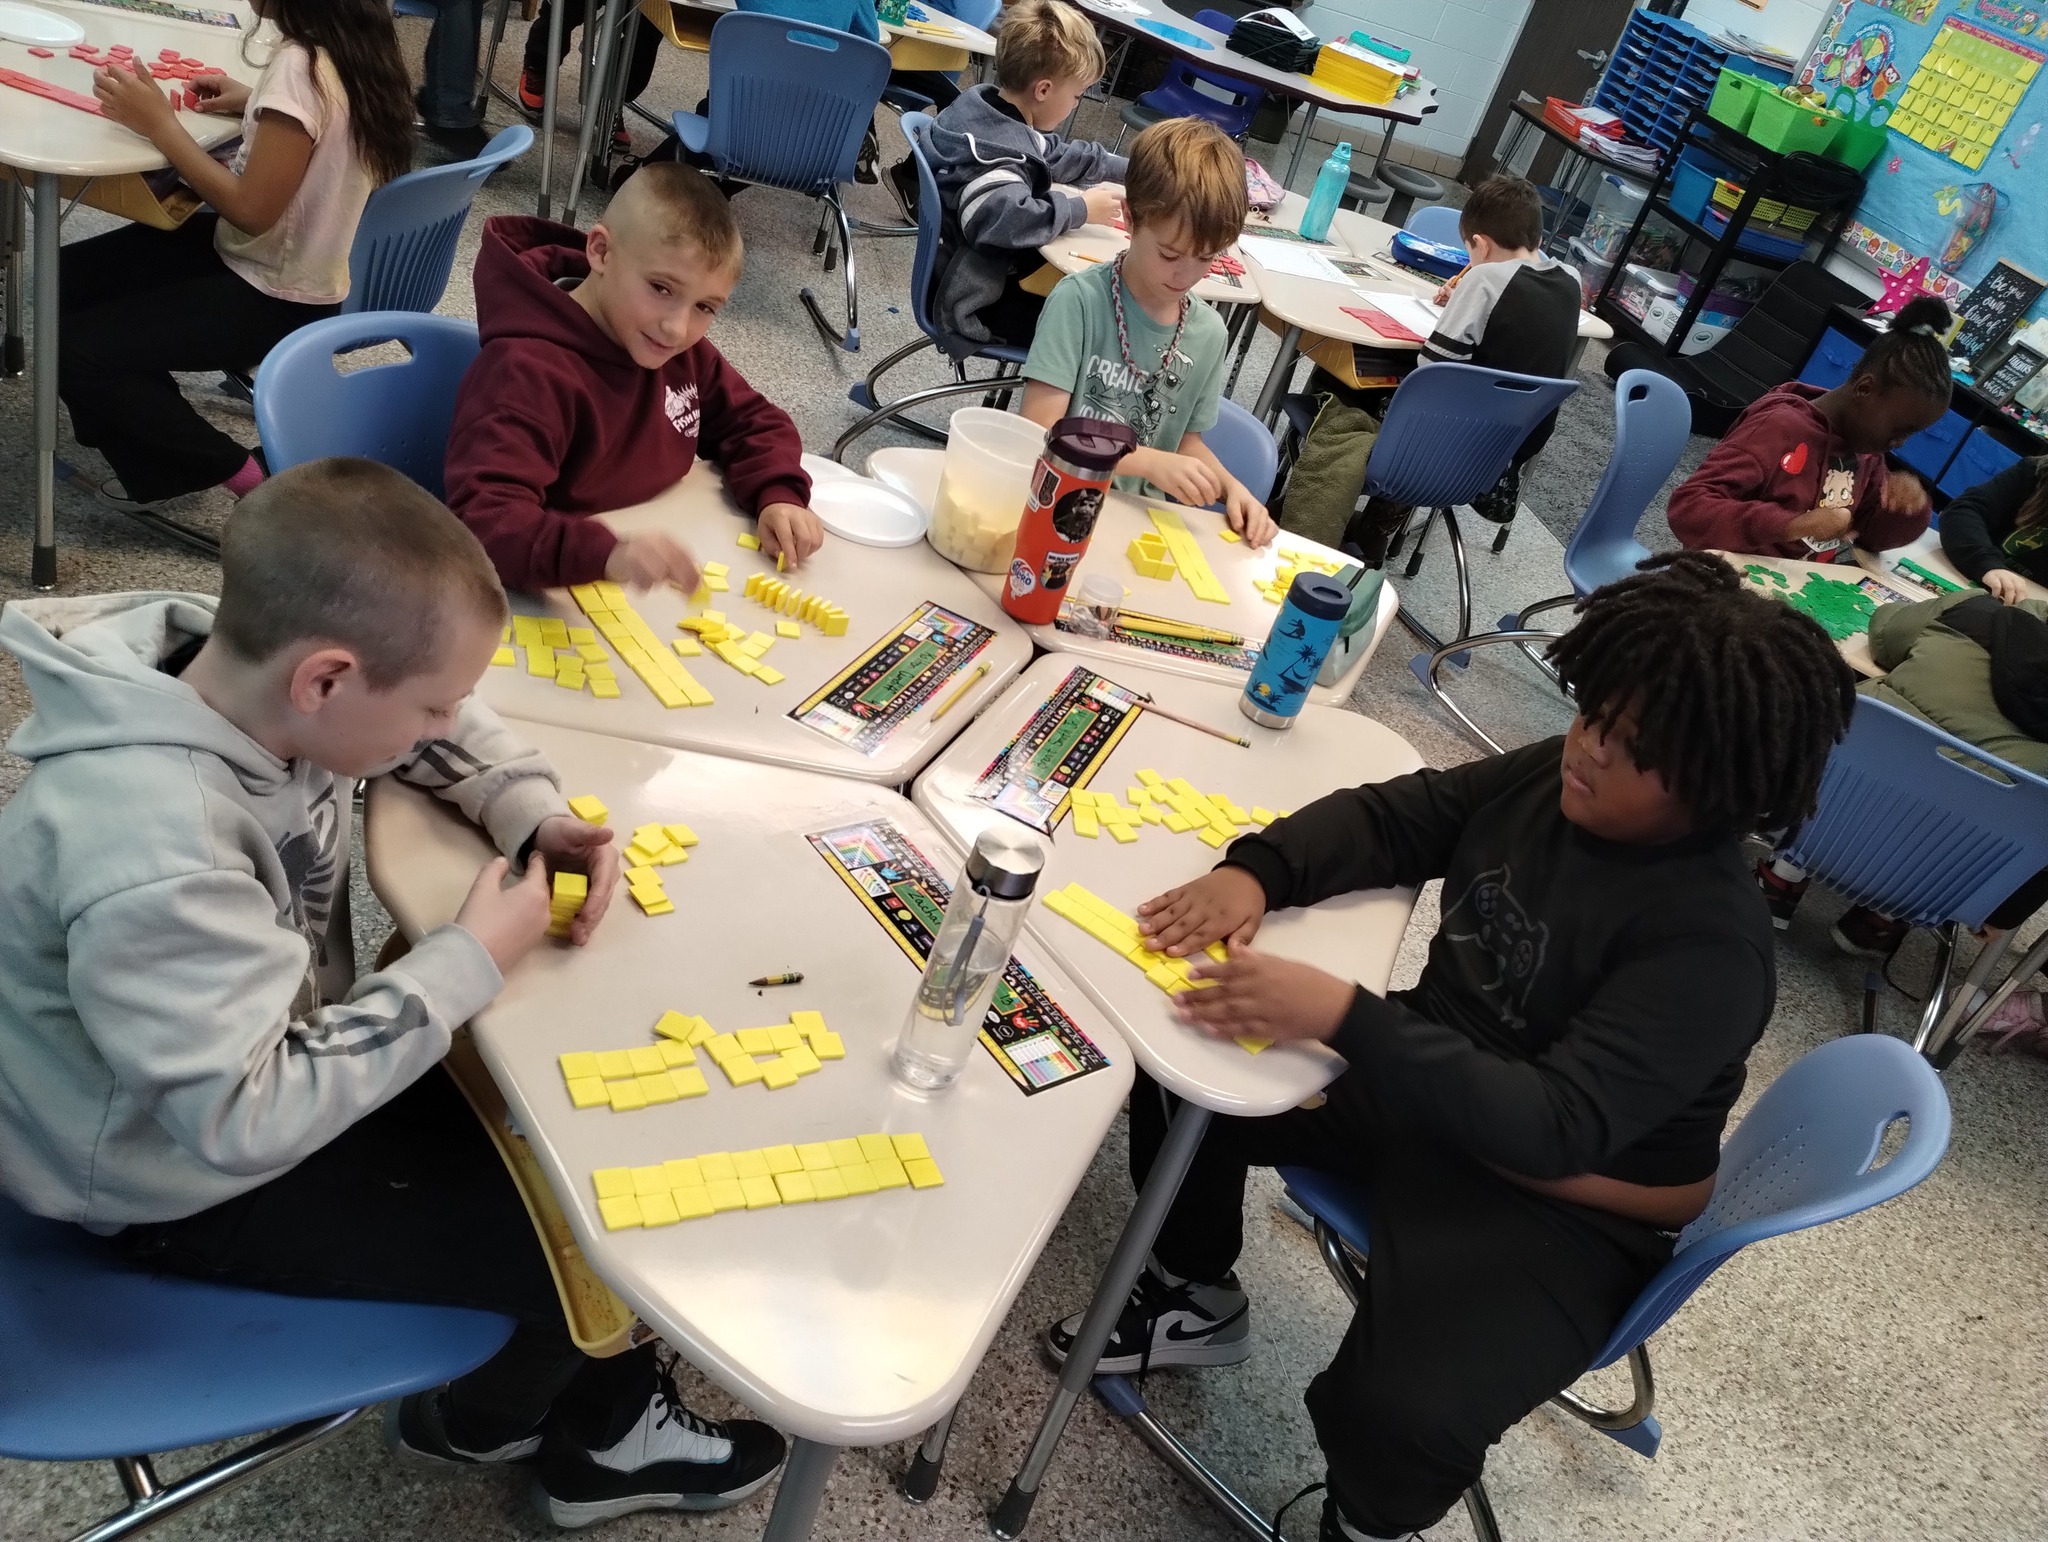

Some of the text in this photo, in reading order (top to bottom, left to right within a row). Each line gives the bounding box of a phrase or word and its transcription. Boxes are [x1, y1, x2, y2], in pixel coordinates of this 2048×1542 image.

[1977, 0, 2019, 22] November
[1990, 274, 2026, 300] Be your
[1982, 296, 2007, 314] own
[1963, 304, 2001, 335] kind of
[1956, 331, 1985, 355] autiful
[1087, 354, 1150, 394] CREATE
[999, 993, 1014, 1006] 13
